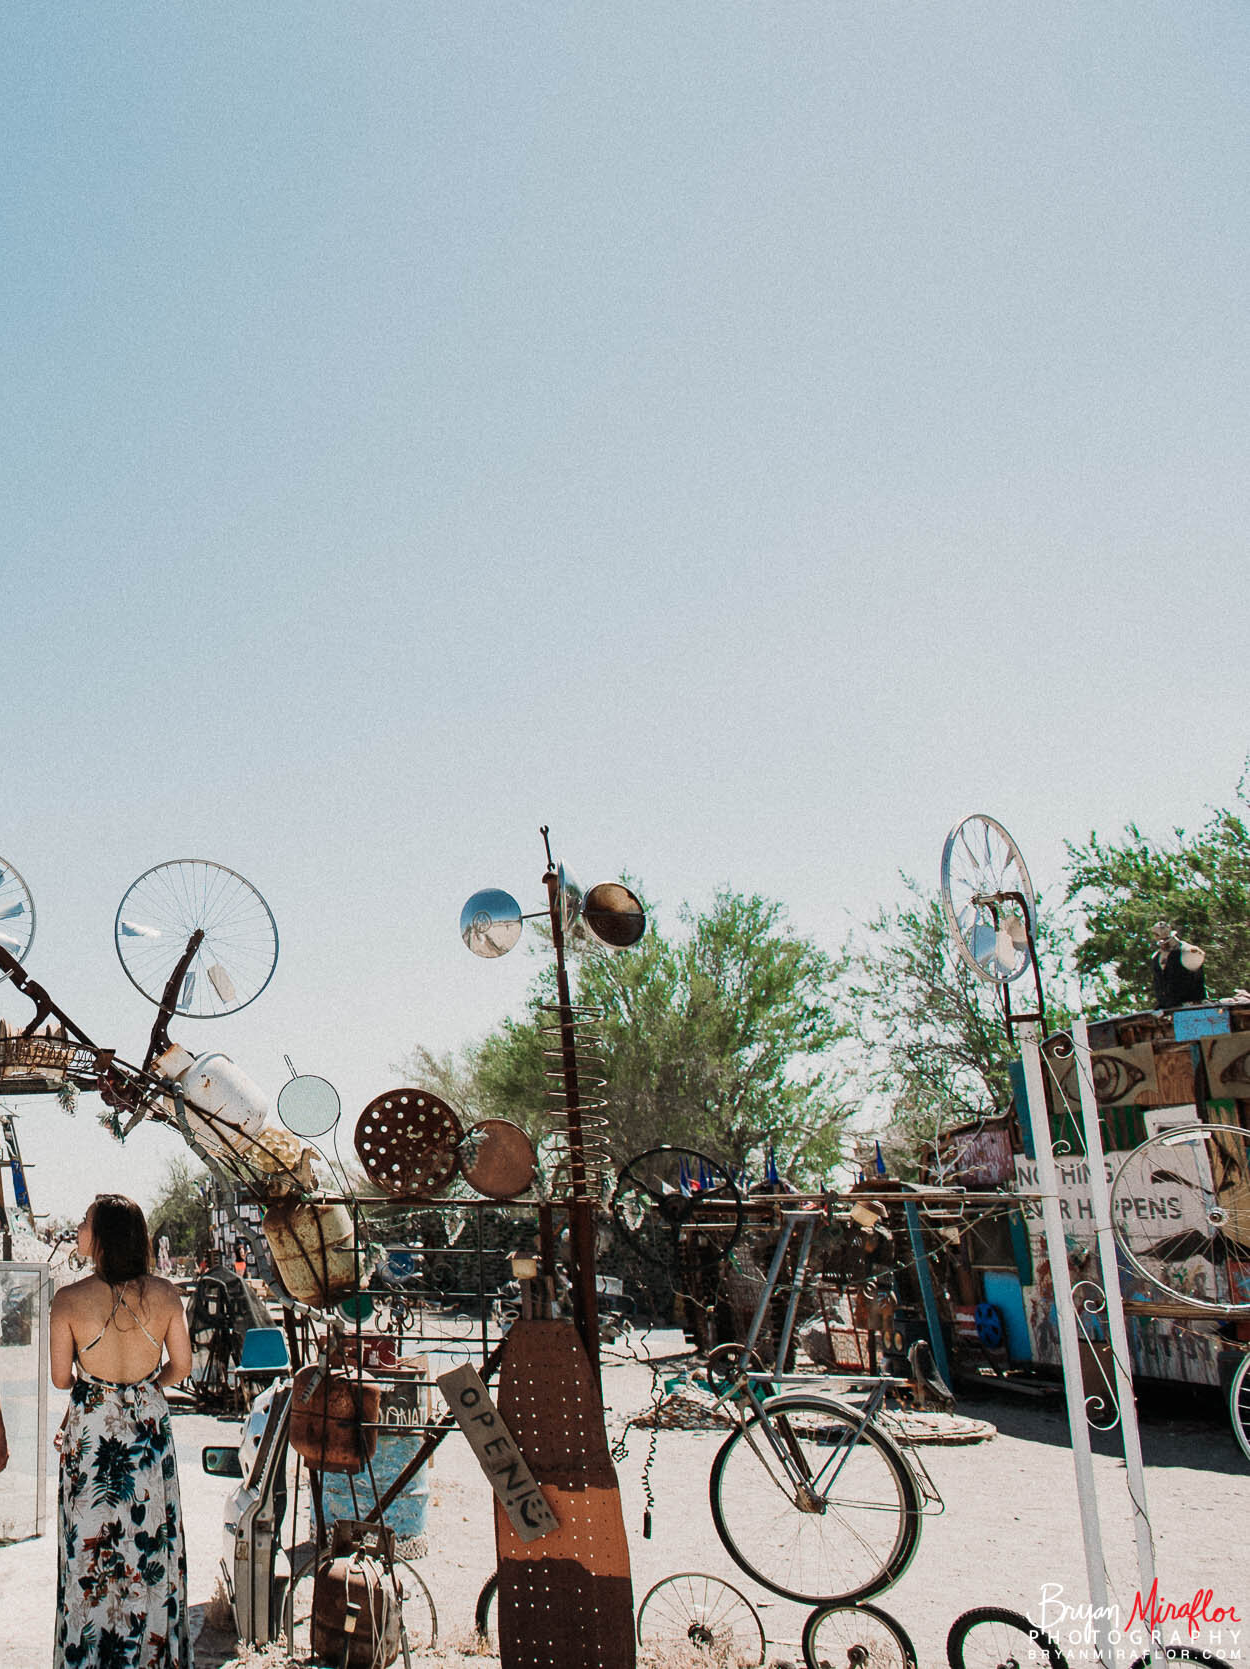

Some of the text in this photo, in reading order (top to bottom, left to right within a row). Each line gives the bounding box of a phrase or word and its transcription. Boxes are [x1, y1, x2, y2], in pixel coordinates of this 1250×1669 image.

[1017, 1162, 1114, 1187] NHING
[1024, 1196, 1183, 1220] EVR HPENS
